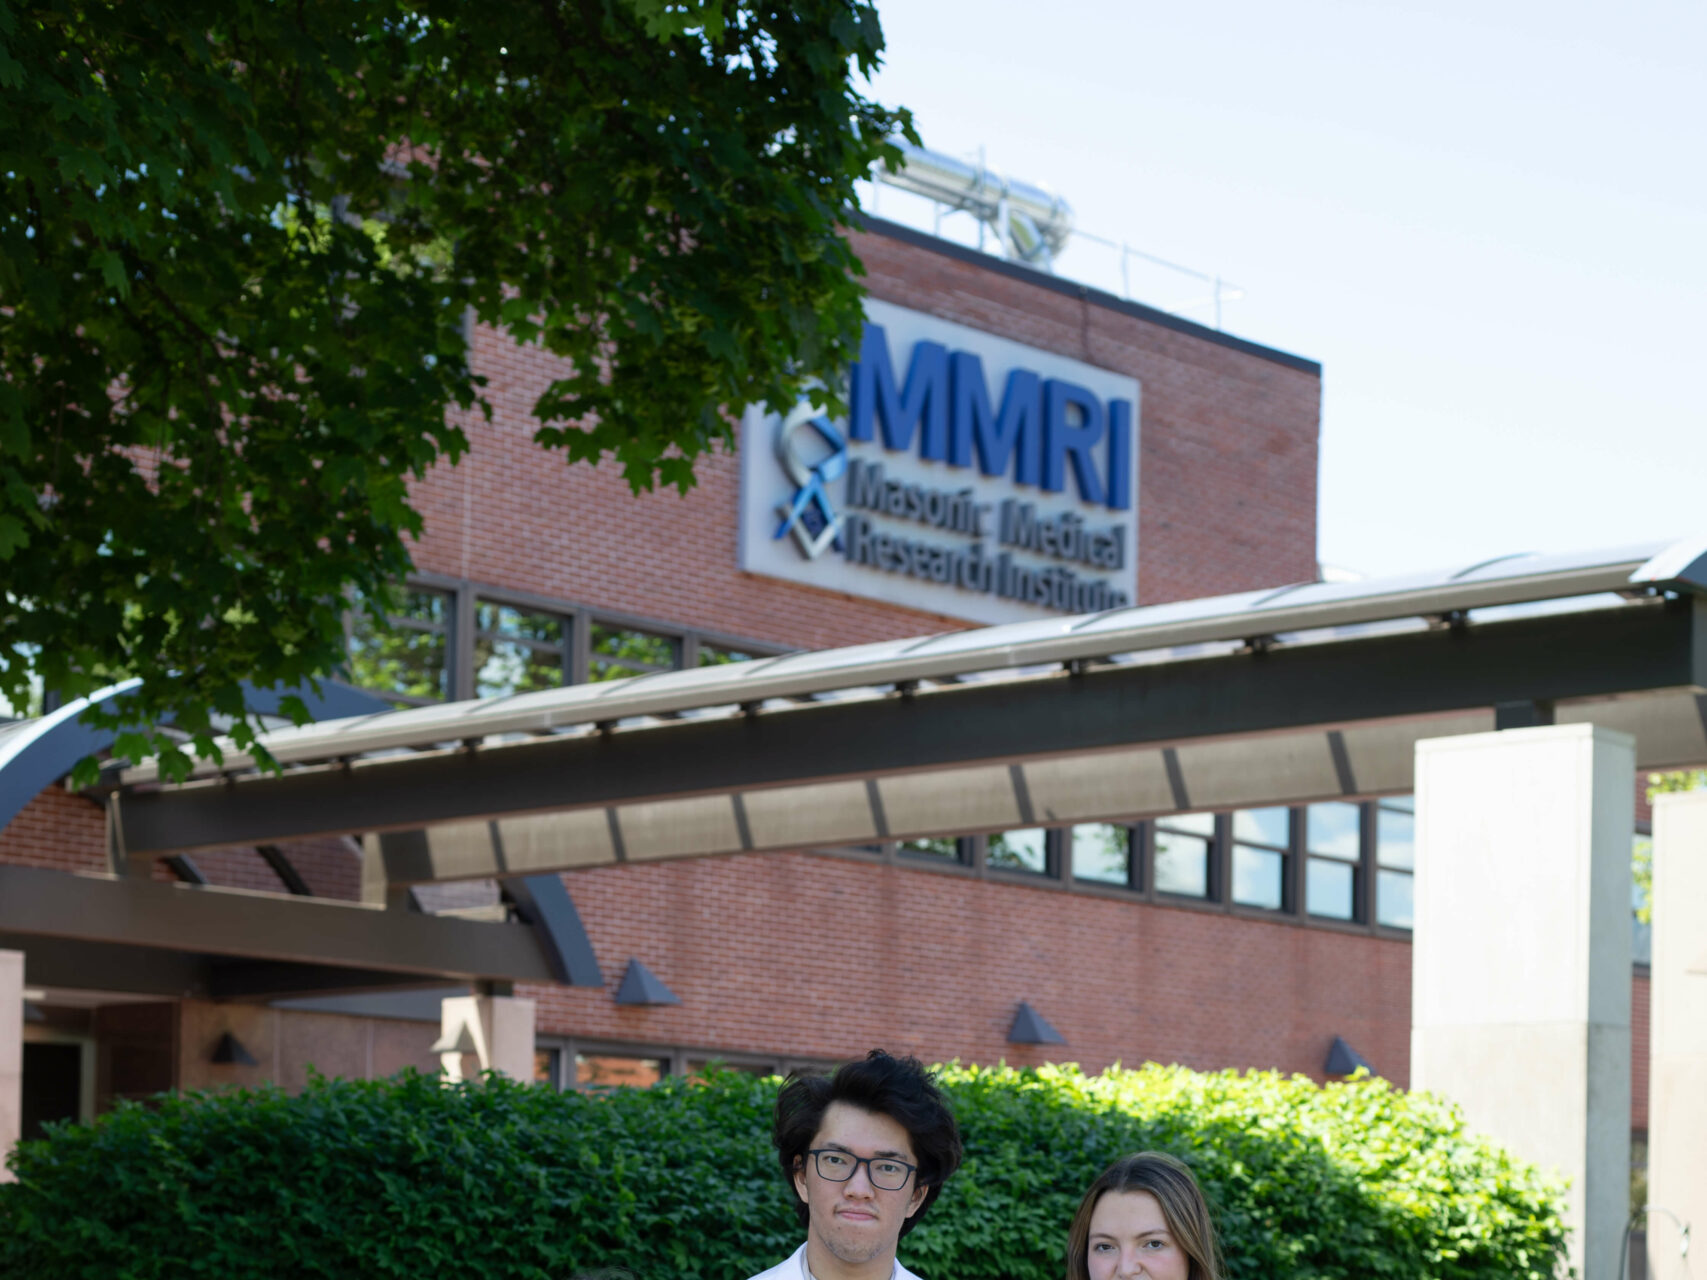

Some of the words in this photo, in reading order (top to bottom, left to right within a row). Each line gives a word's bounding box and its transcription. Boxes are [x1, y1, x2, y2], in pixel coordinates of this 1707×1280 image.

[851, 323, 1130, 511] MMRI
[845, 459, 991, 538] Masonic
[1000, 499, 1125, 571] Medical
[845, 515, 998, 595] Research
